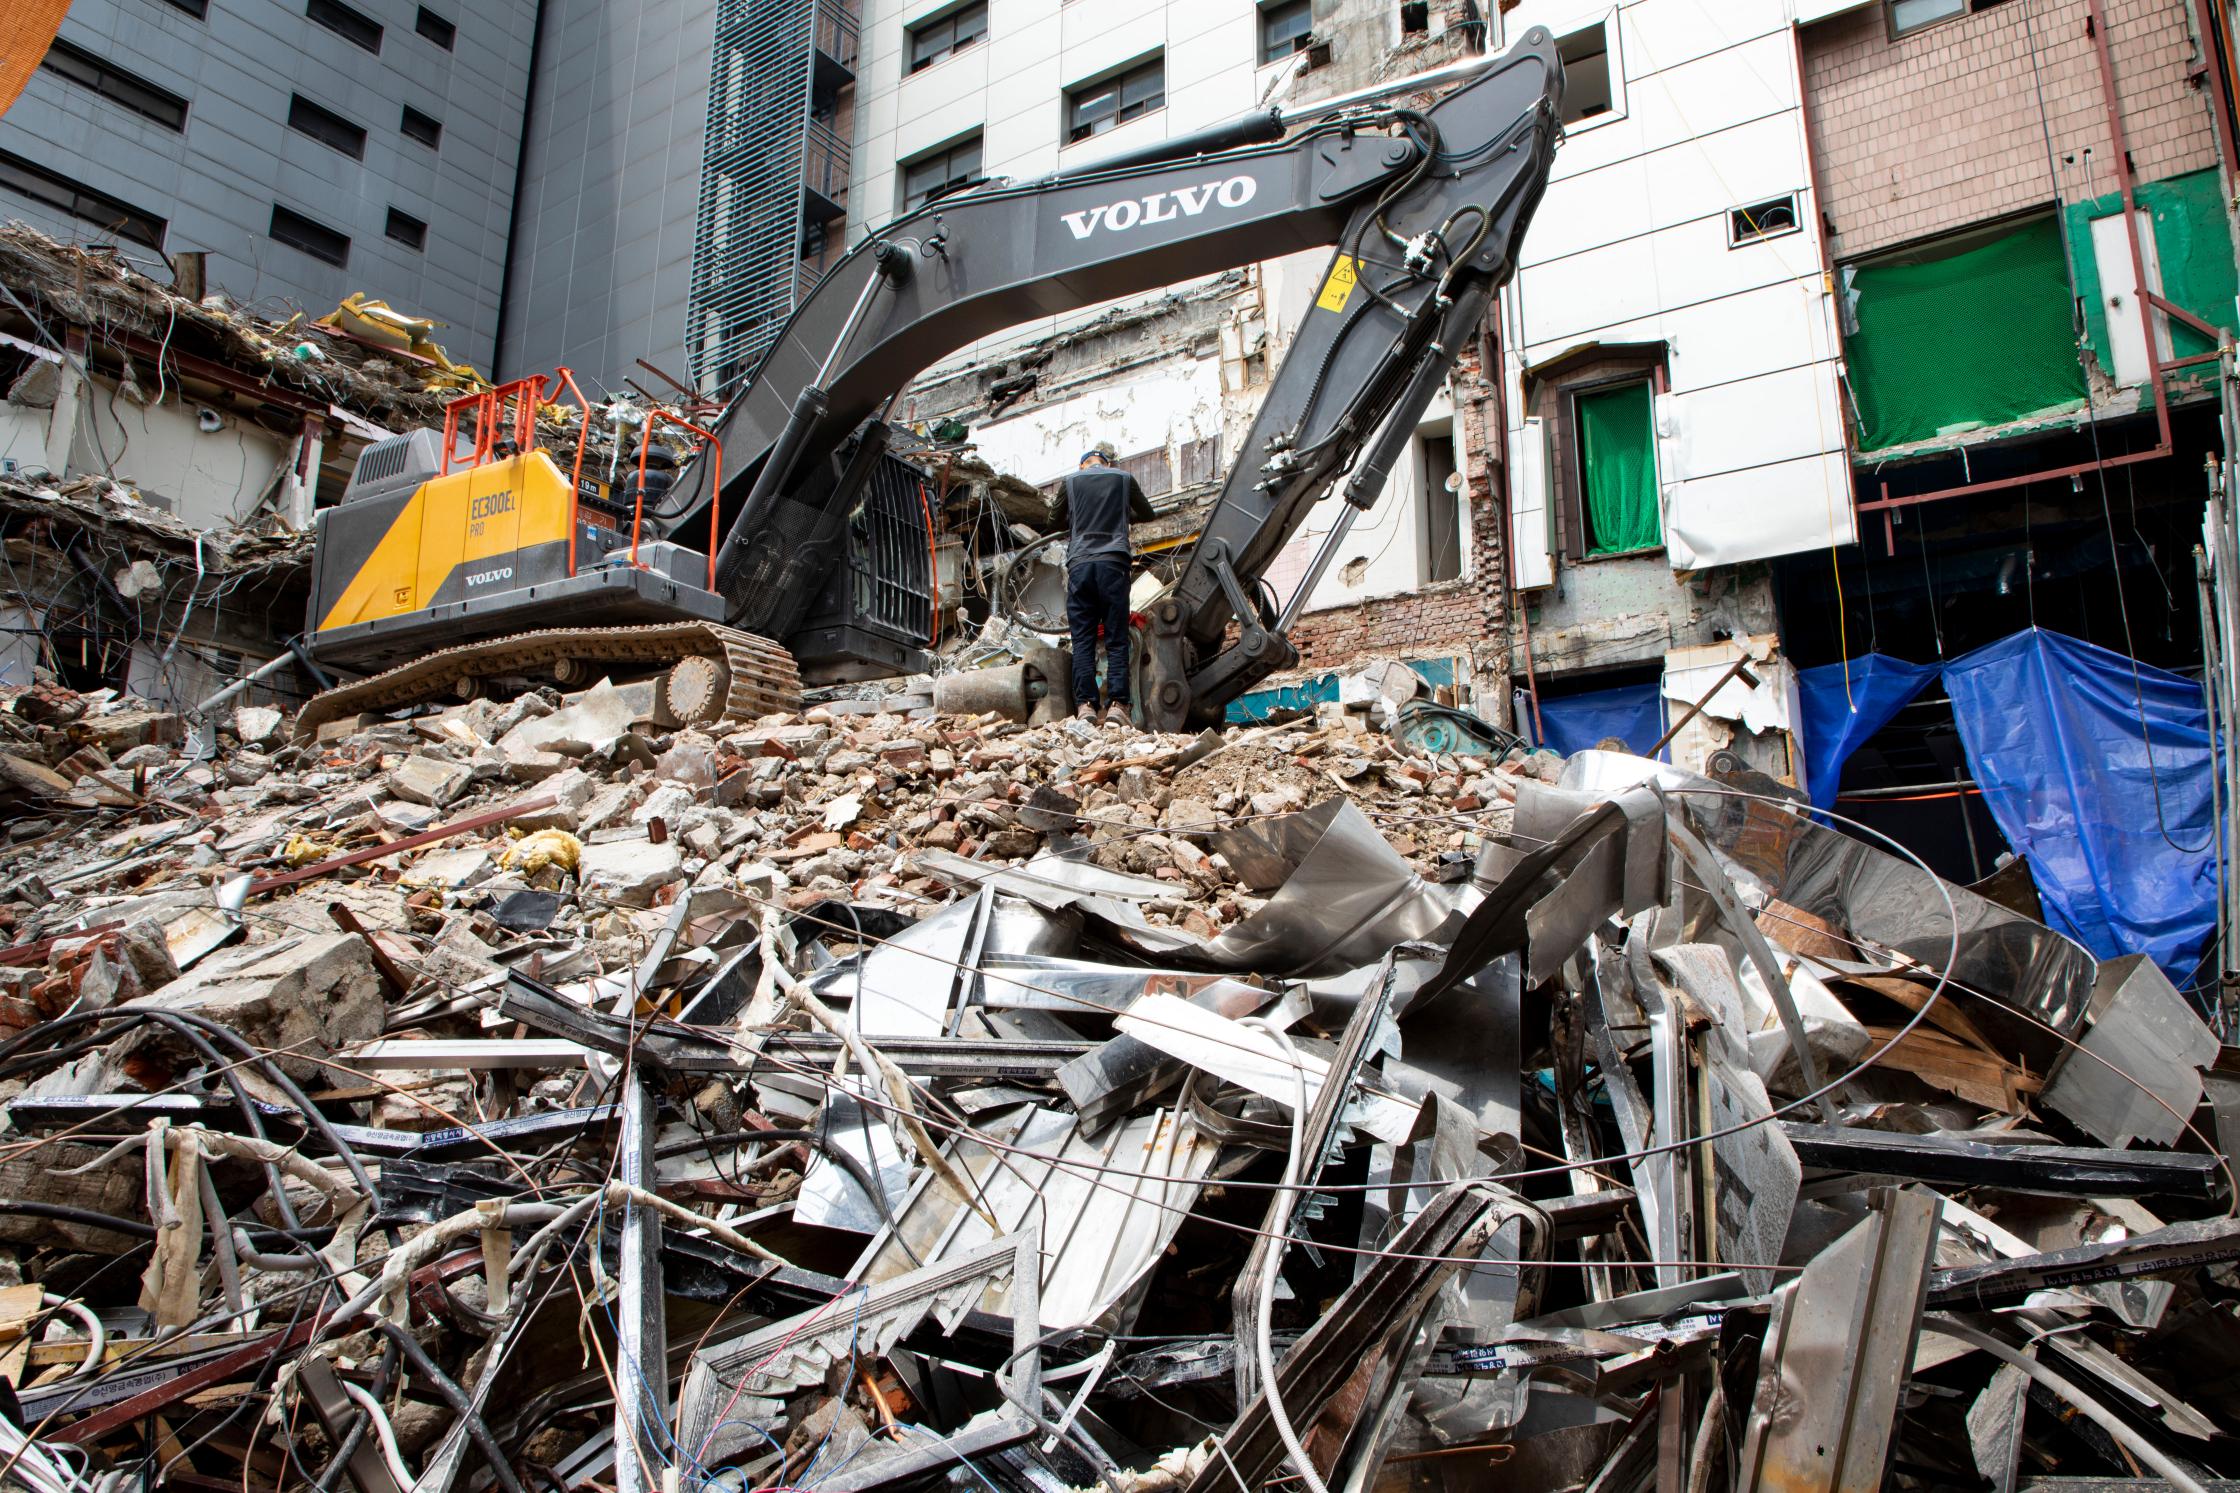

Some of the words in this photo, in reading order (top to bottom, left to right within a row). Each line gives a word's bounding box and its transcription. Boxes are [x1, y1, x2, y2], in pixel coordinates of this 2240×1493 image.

[1060, 175, 1257, 240] VOLVO
[470, 521, 485, 538] PRO
[465, 567, 513, 586] VOLVO
